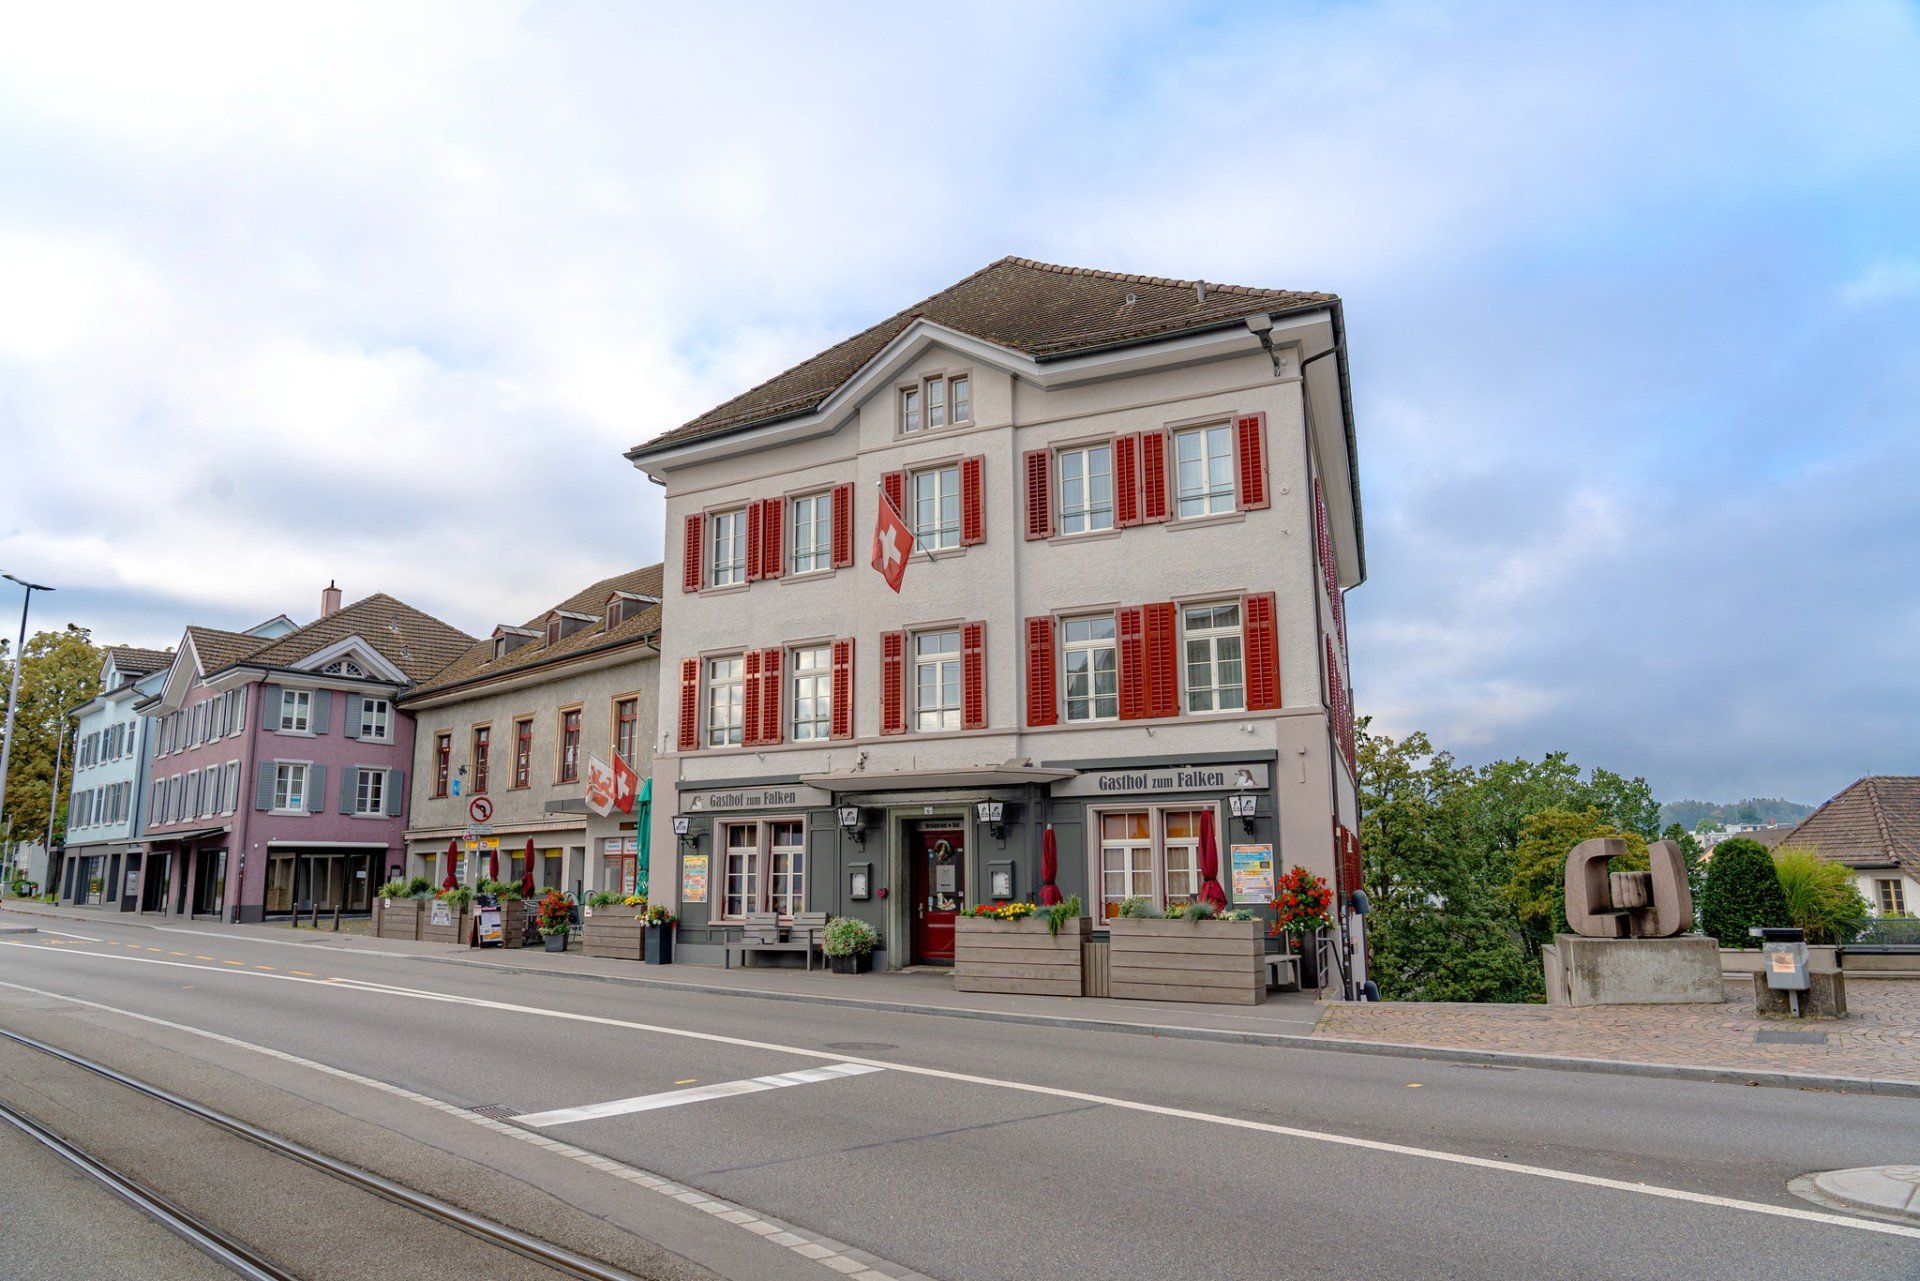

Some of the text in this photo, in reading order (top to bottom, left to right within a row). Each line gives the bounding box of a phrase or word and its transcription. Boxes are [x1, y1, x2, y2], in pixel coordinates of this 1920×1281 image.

[1099, 770, 1224, 791] Gasthof zum Falken
[710, 790, 796, 808] Gasthof zum Falken
